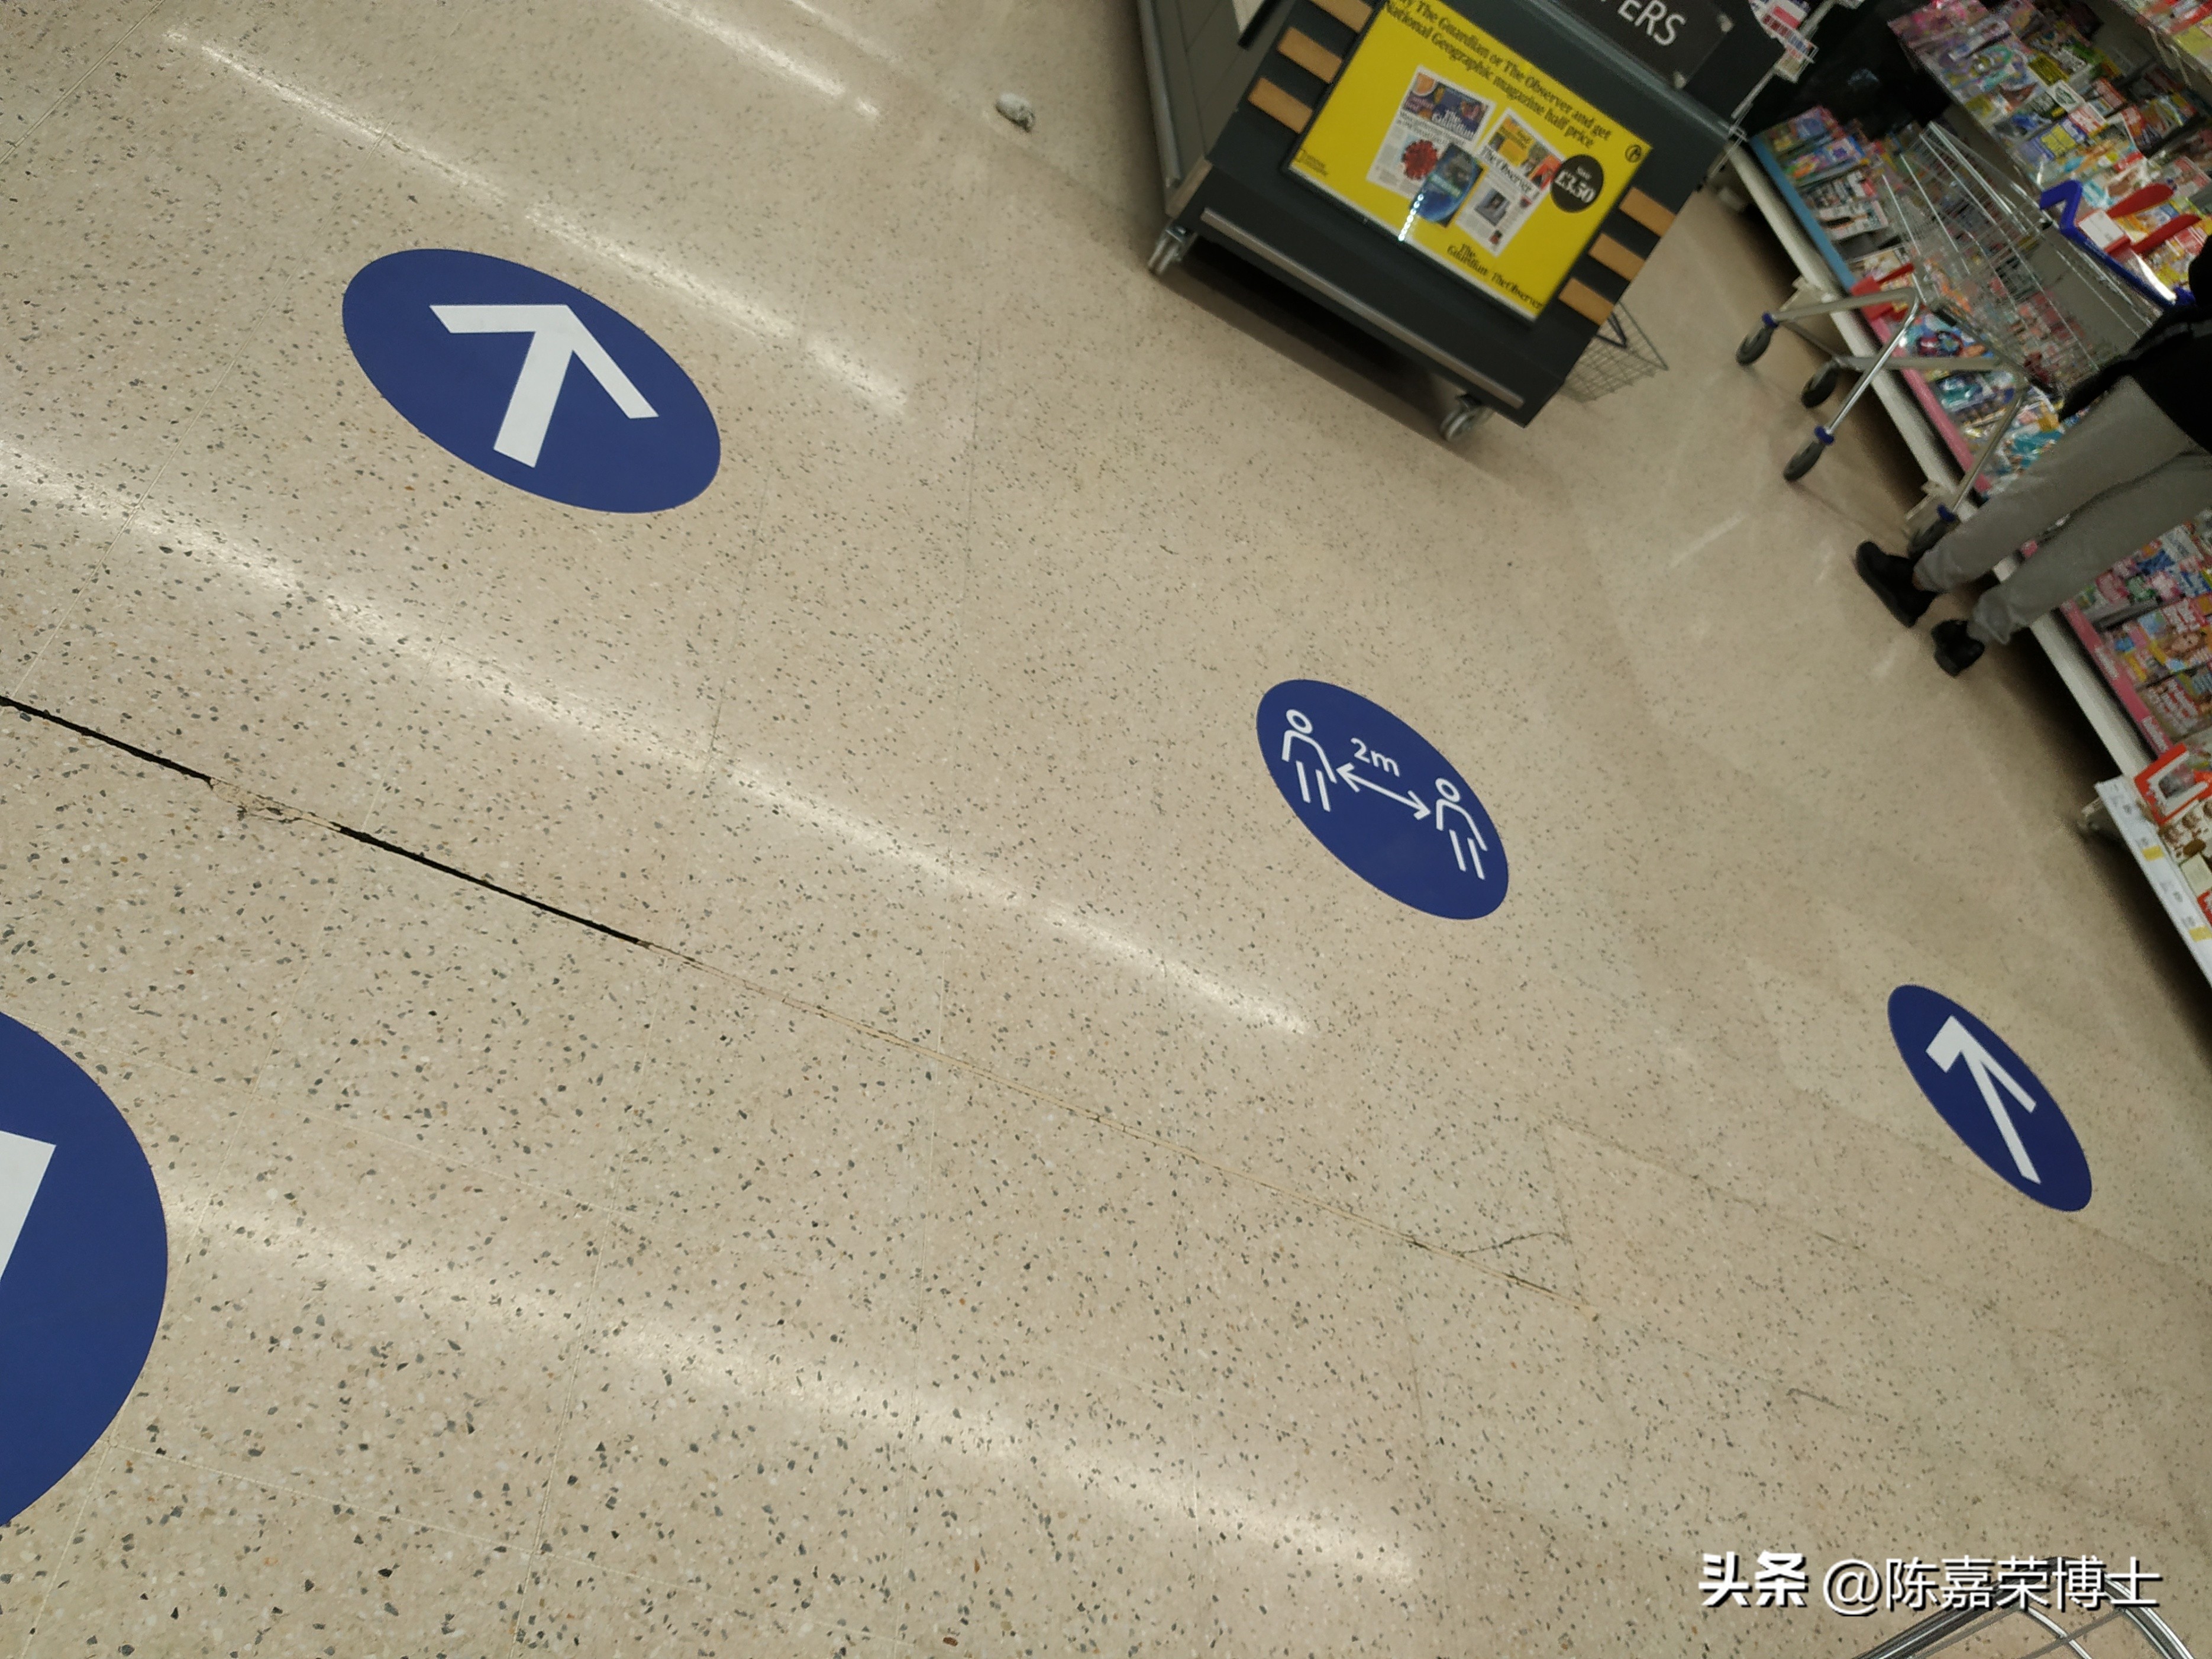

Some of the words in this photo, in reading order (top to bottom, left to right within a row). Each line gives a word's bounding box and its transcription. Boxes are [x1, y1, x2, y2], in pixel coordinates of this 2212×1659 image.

[1601, 0, 1686, 46] ERS
[1417, 0, 1438, 22] The
[1438, 17, 1490, 59] Guardian
[1489, 54, 1503, 66] or
[1504, 60, 1525, 82] The
[1525, 76, 1573, 114] Observer
[1571, 111, 1595, 129] and
[1591, 125, 1612, 141] get
[1432, 32, 1493, 80] Geographic
[1493, 75, 1545, 116] magazine
[1544, 108, 1570, 131] half
[1564, 125, 1594, 149] price
[1554, 170, 1597, 204] £3.50
[1351, 737, 1400, 777] 2m
